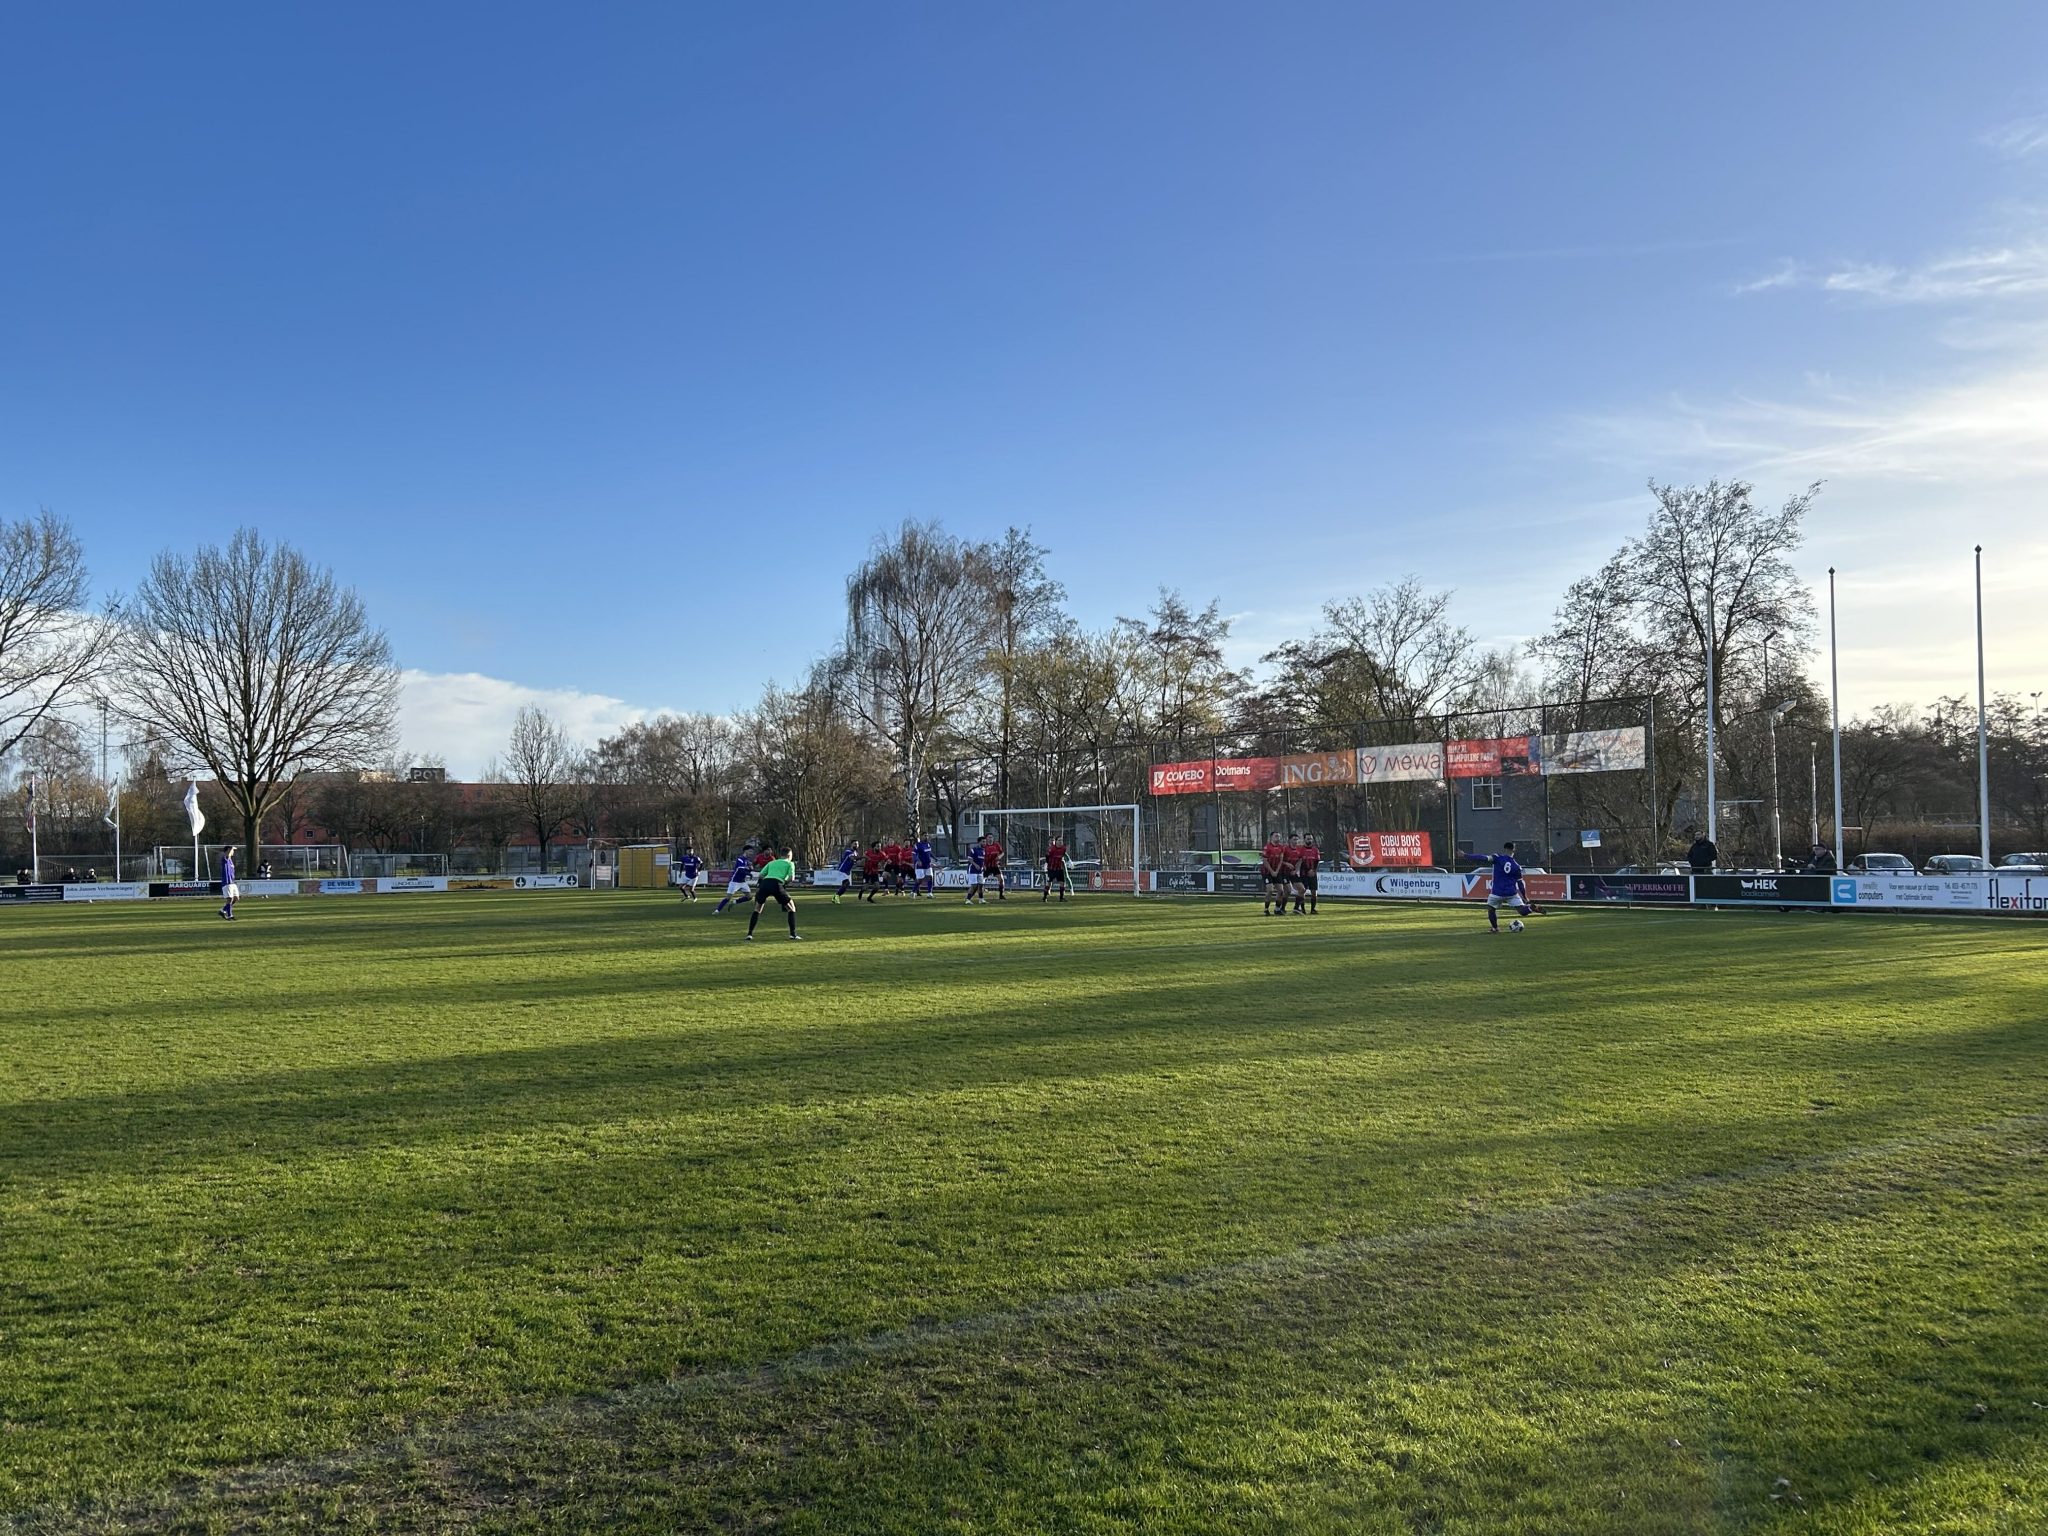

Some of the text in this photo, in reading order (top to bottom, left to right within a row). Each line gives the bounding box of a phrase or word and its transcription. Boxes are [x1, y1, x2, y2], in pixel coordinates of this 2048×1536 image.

[1166, 769, 1204, 782] COVEBO
[1282, 762, 1323, 784] ING
[1381, 834, 1421, 847] COBU BOYS
[1382, 846, 1422, 857] CLUB VAN 100
[1504, 862, 1511, 873] 6
[1356, 875, 1366, 883] 100
[1390, 878, 1440, 890] Wilgenburg
[1754, 879, 1777, 890] HEK
[1858, 891, 1884, 902] computers
